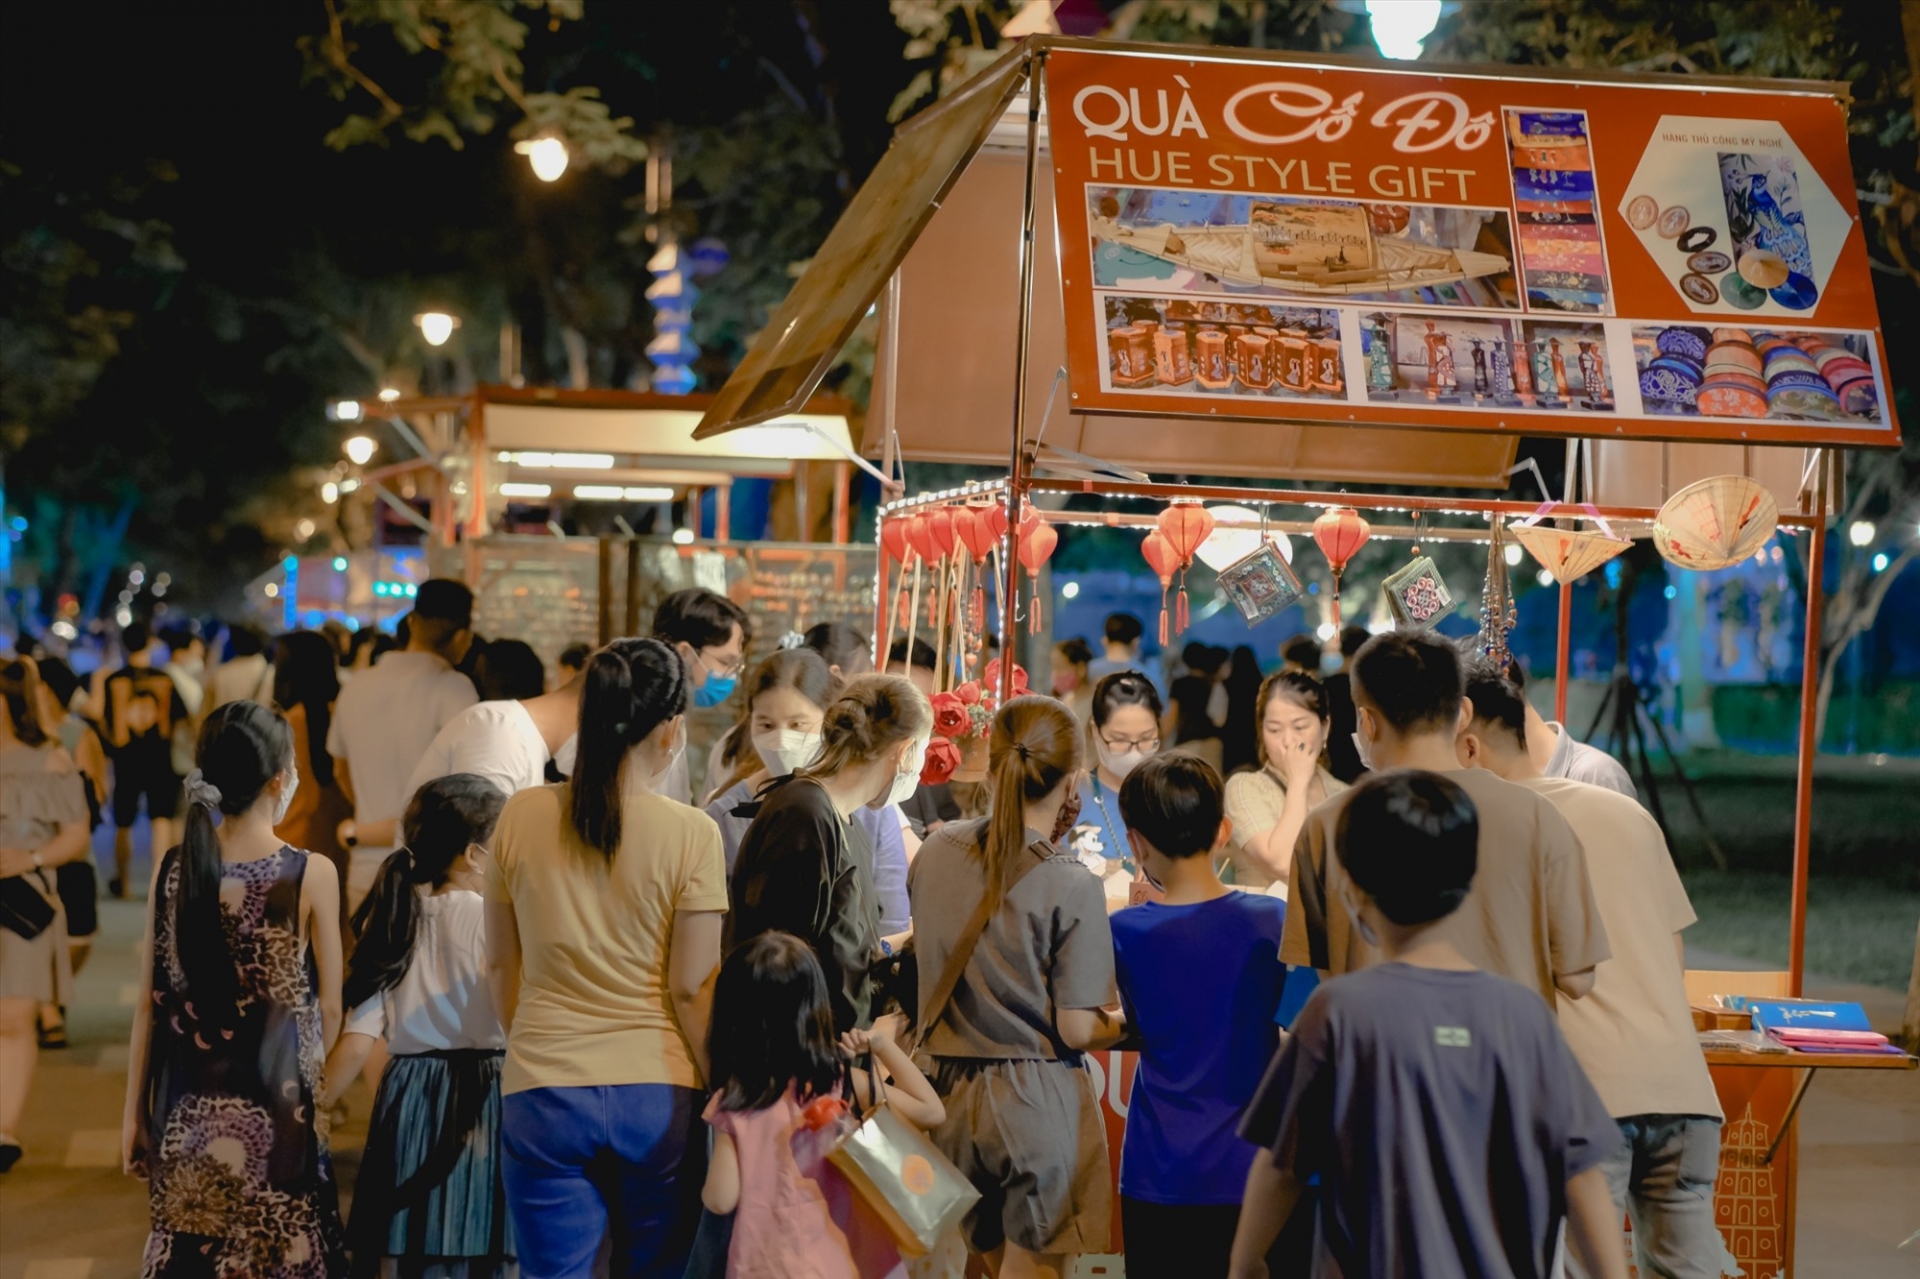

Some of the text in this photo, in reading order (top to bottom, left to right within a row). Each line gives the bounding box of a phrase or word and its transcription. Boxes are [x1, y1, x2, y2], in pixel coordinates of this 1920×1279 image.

[1073, 75, 1209, 141] QUÀ
[1089, 147, 1476, 201] HUE STYLE GIFT
